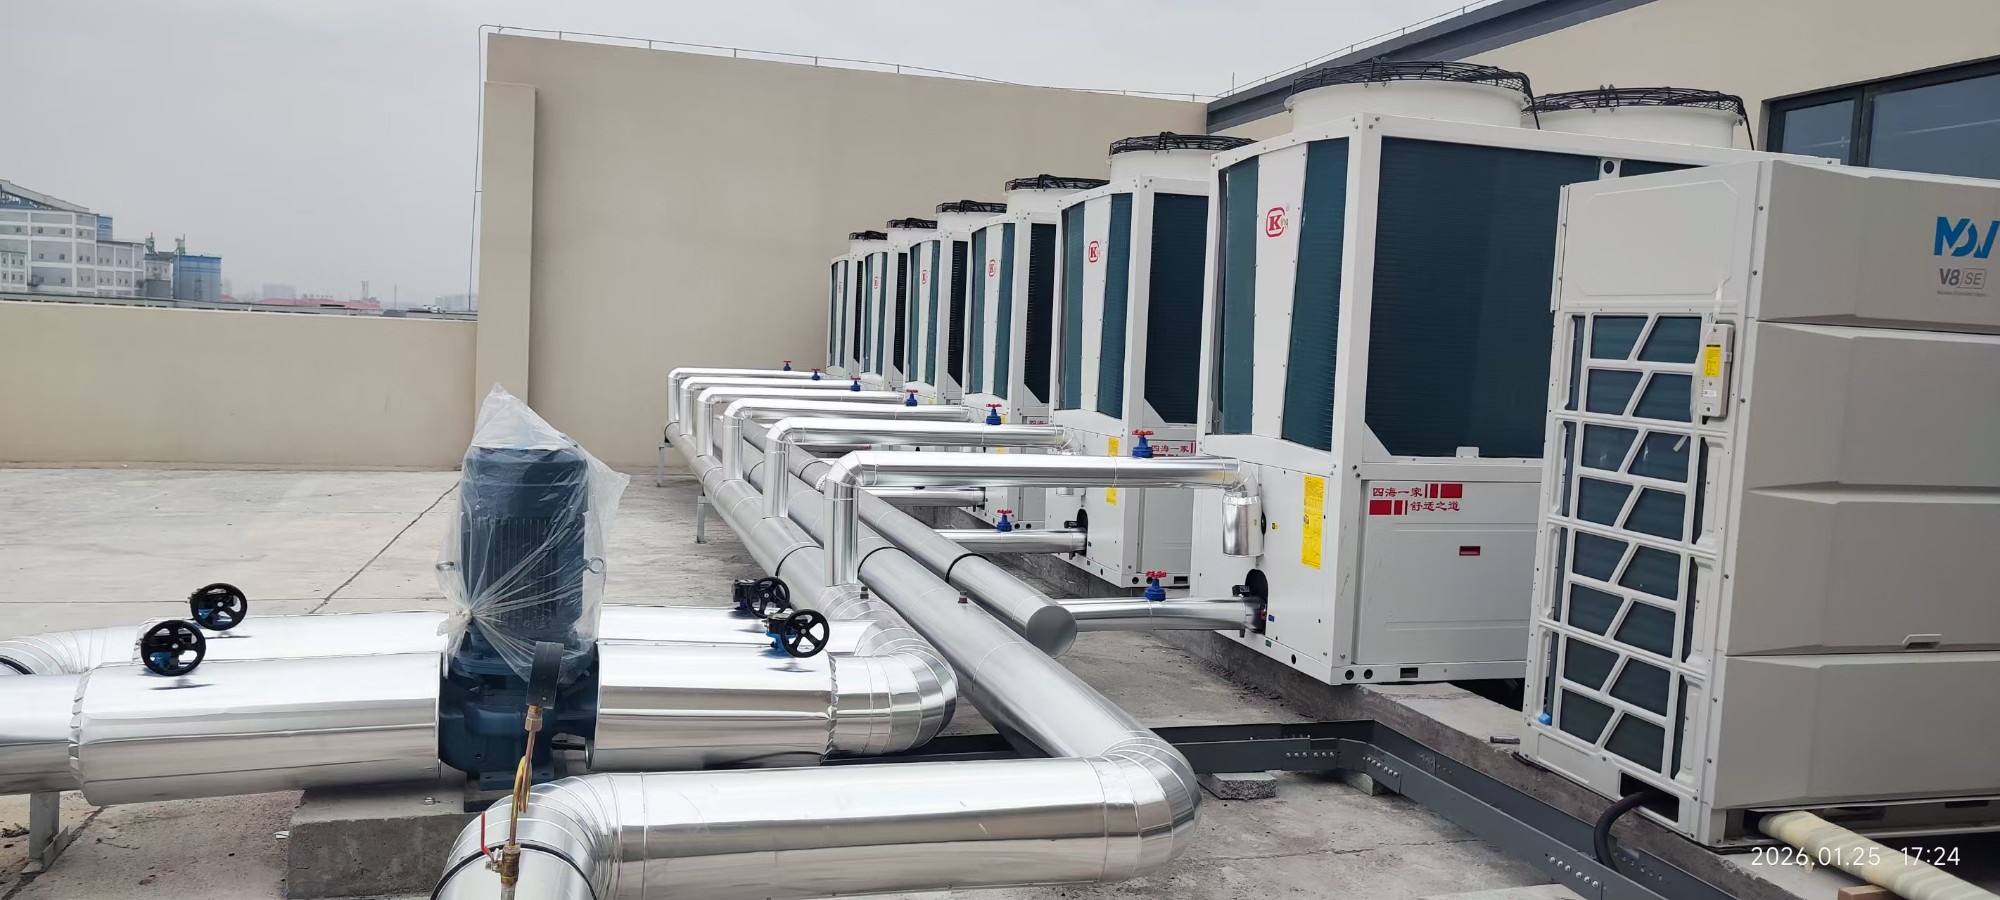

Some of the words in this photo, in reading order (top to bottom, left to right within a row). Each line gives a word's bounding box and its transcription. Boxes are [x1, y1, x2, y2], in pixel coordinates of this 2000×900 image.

[1939, 268, 1961, 286] V8
[1964, 272, 1983, 285] SE
[1372, 487, 1423, 497] 四海一家
[1410, 501, 1460, 511] 舒适之道
